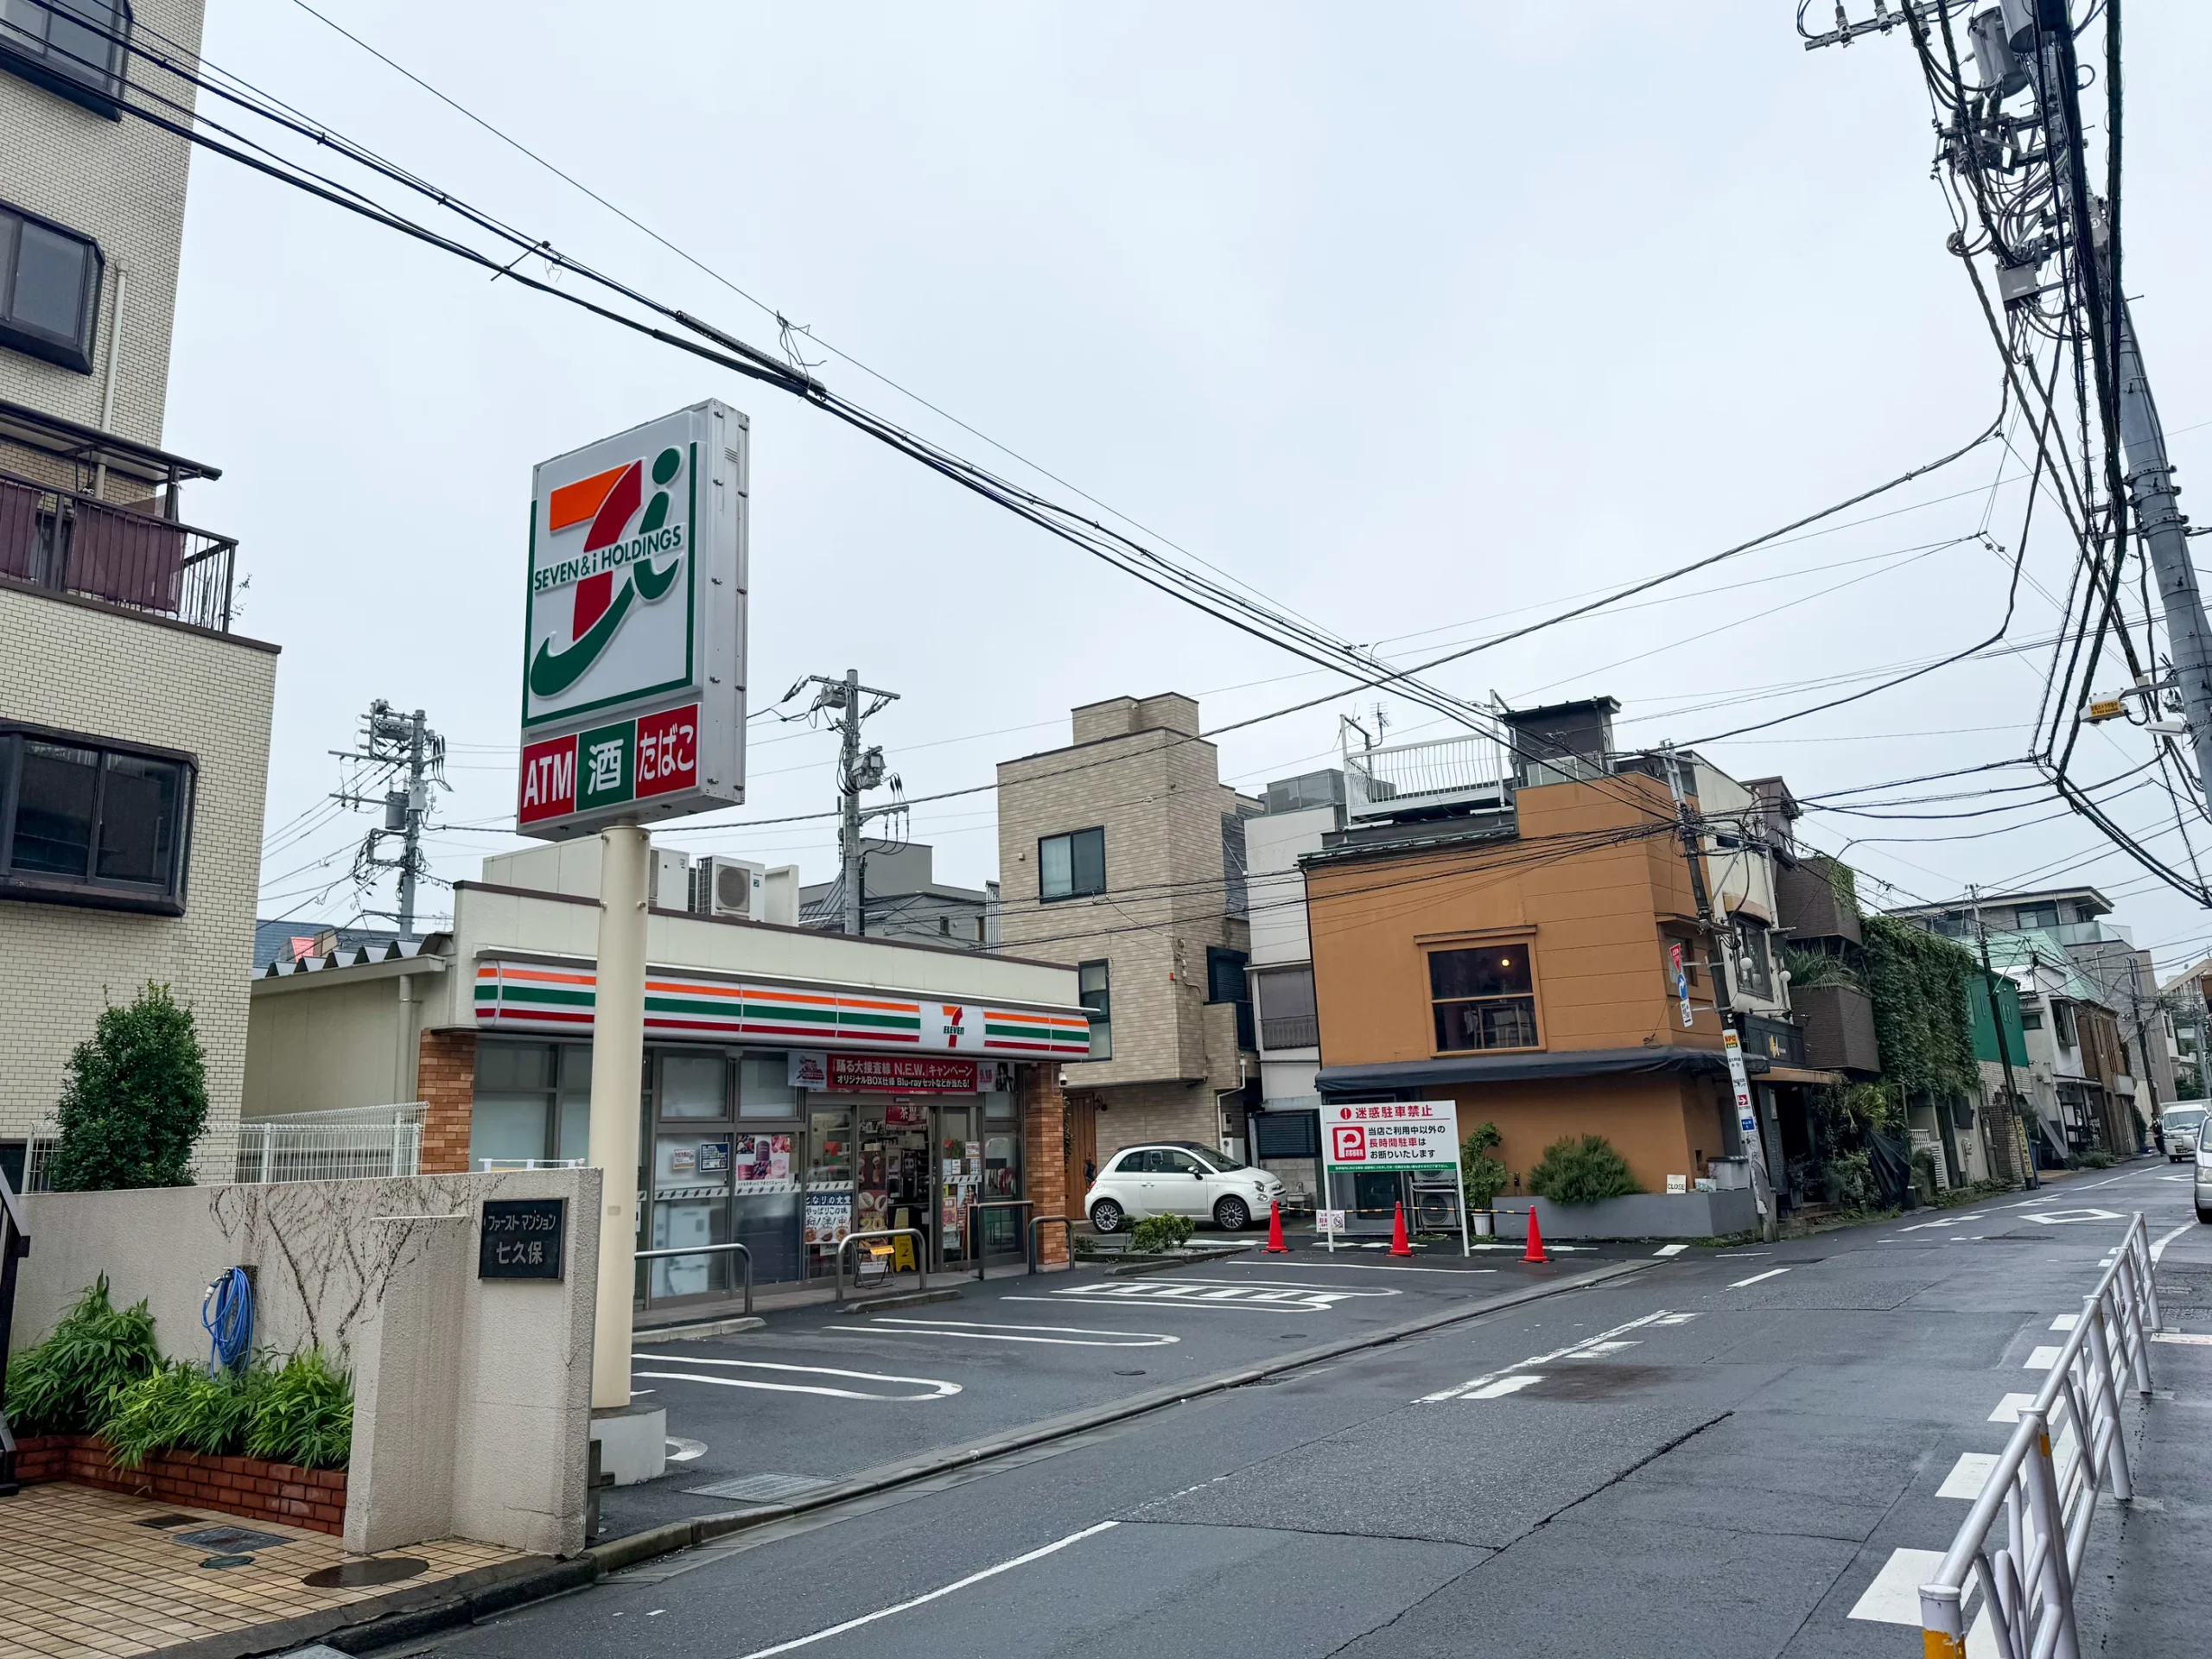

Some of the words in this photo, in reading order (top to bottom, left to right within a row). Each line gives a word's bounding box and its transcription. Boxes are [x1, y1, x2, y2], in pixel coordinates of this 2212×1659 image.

[601, 524, 683, 572] HOLDINGS
[522, 750, 574, 809] ATM
[587, 738, 624, 797] 酒
[638, 723, 695, 783] たばこ
[1356, 1105, 1433, 1119] 迷惑駐車禁止
[1368, 1126, 1446, 1136] 当店ご利用中以外の
[1369, 1137, 1427, 1148] 長時間駐車は
[1370, 1149, 1435, 1159] お断りいたします
[487, 1215, 520, 1231] ファースト
[521, 1214, 556, 1230] マンション
[496, 1241, 543, 1265] 七久保
